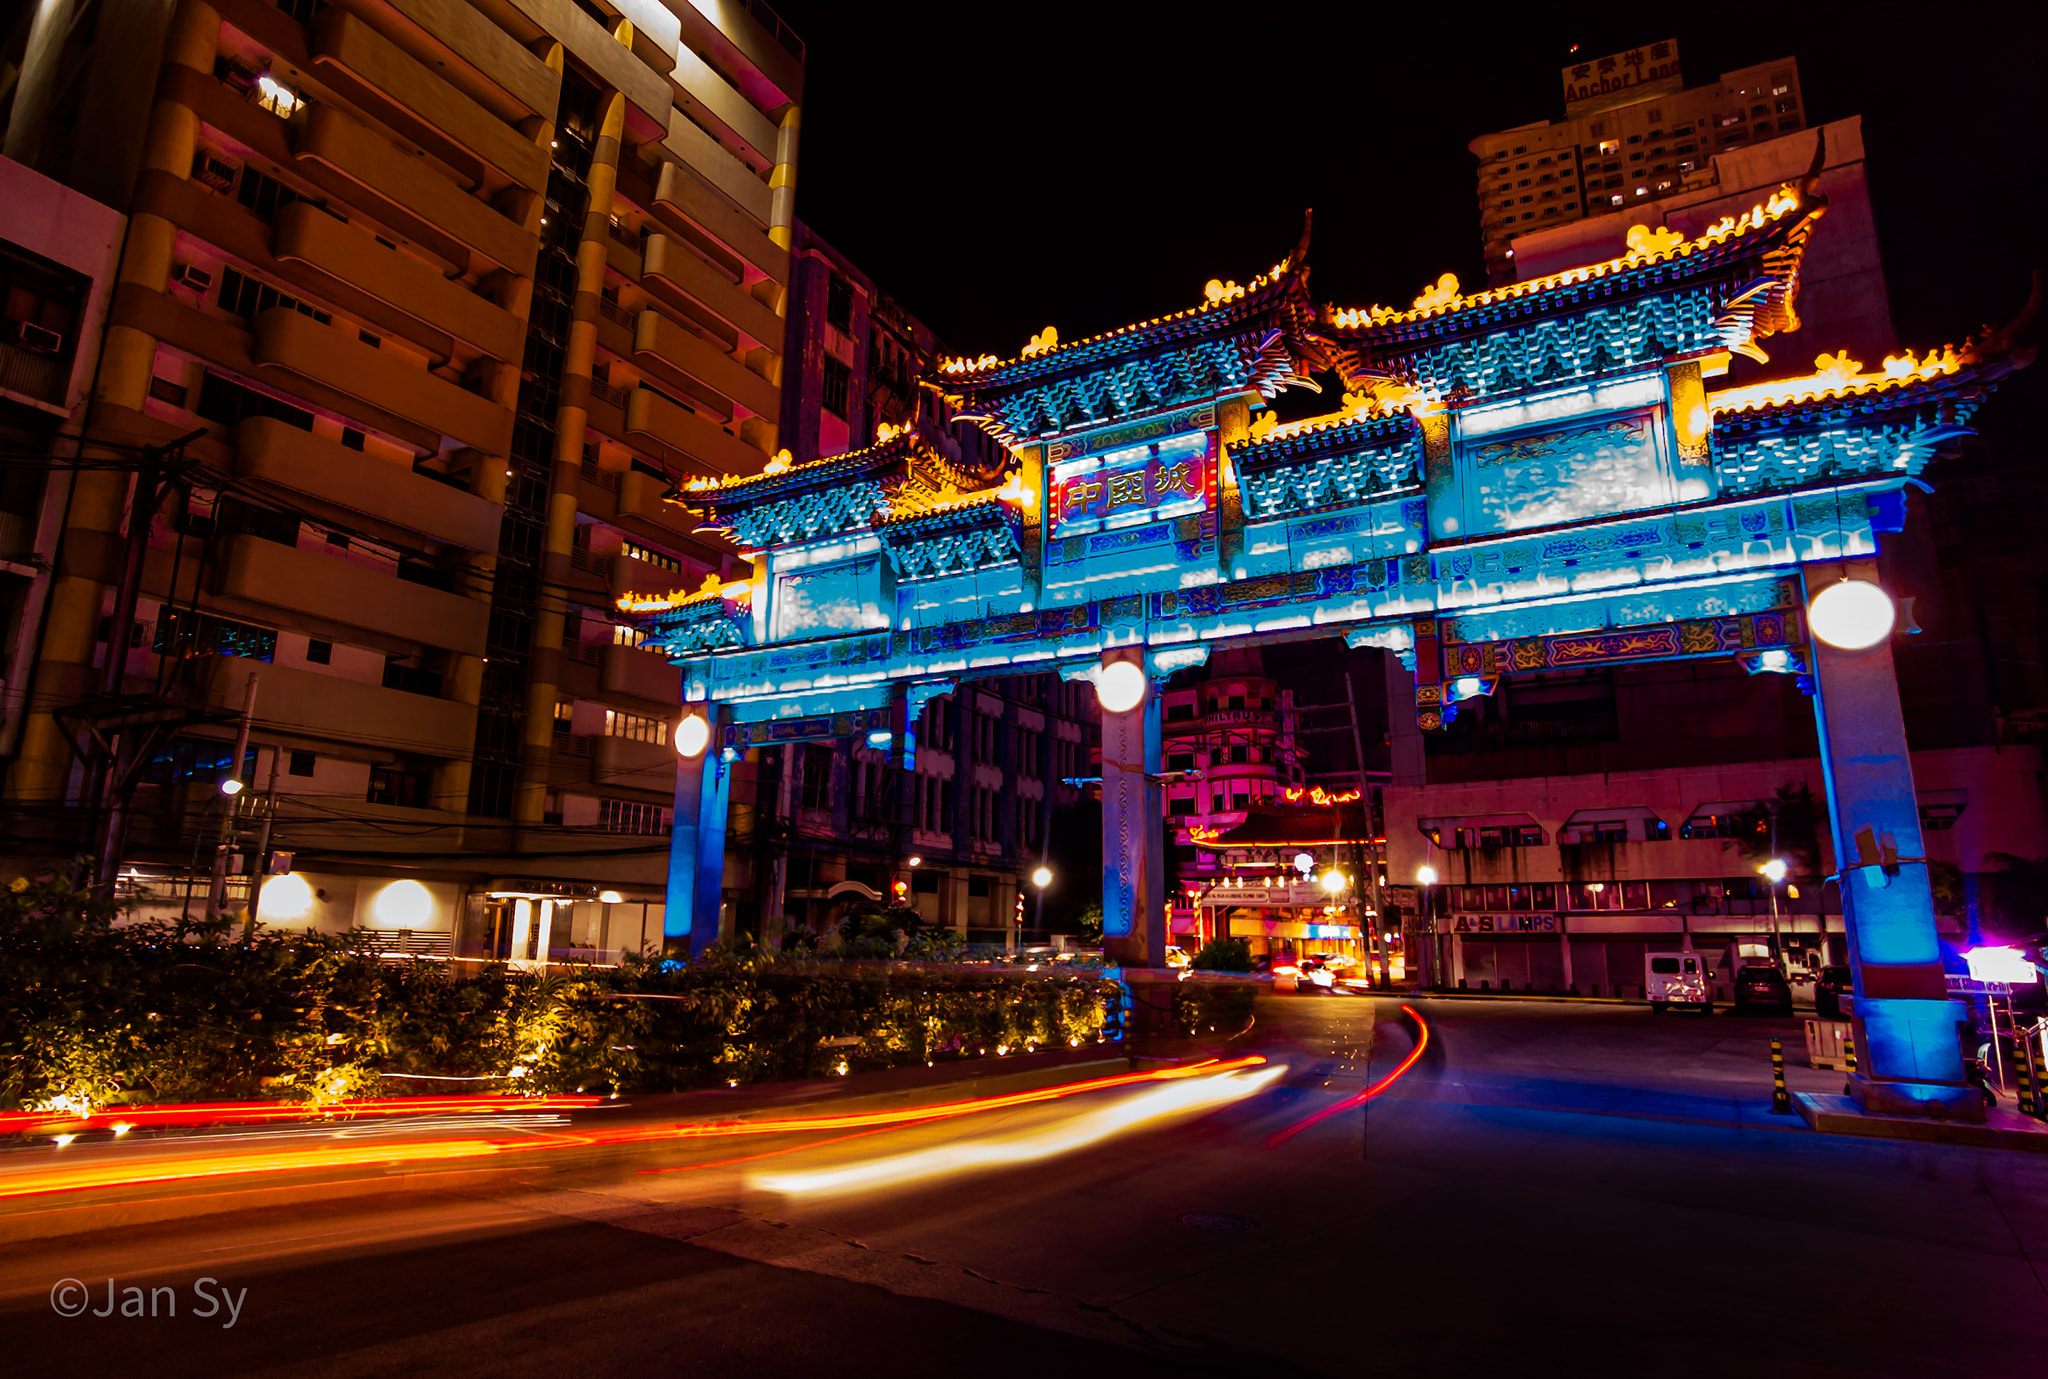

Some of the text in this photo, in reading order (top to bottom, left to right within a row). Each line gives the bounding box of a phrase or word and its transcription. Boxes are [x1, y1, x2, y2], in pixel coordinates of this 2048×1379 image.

[1566, 72, 1630, 101] Anchor
[1065, 462, 1195, 514] 中國城
[1497, 916, 1554, 931] LAMPS
